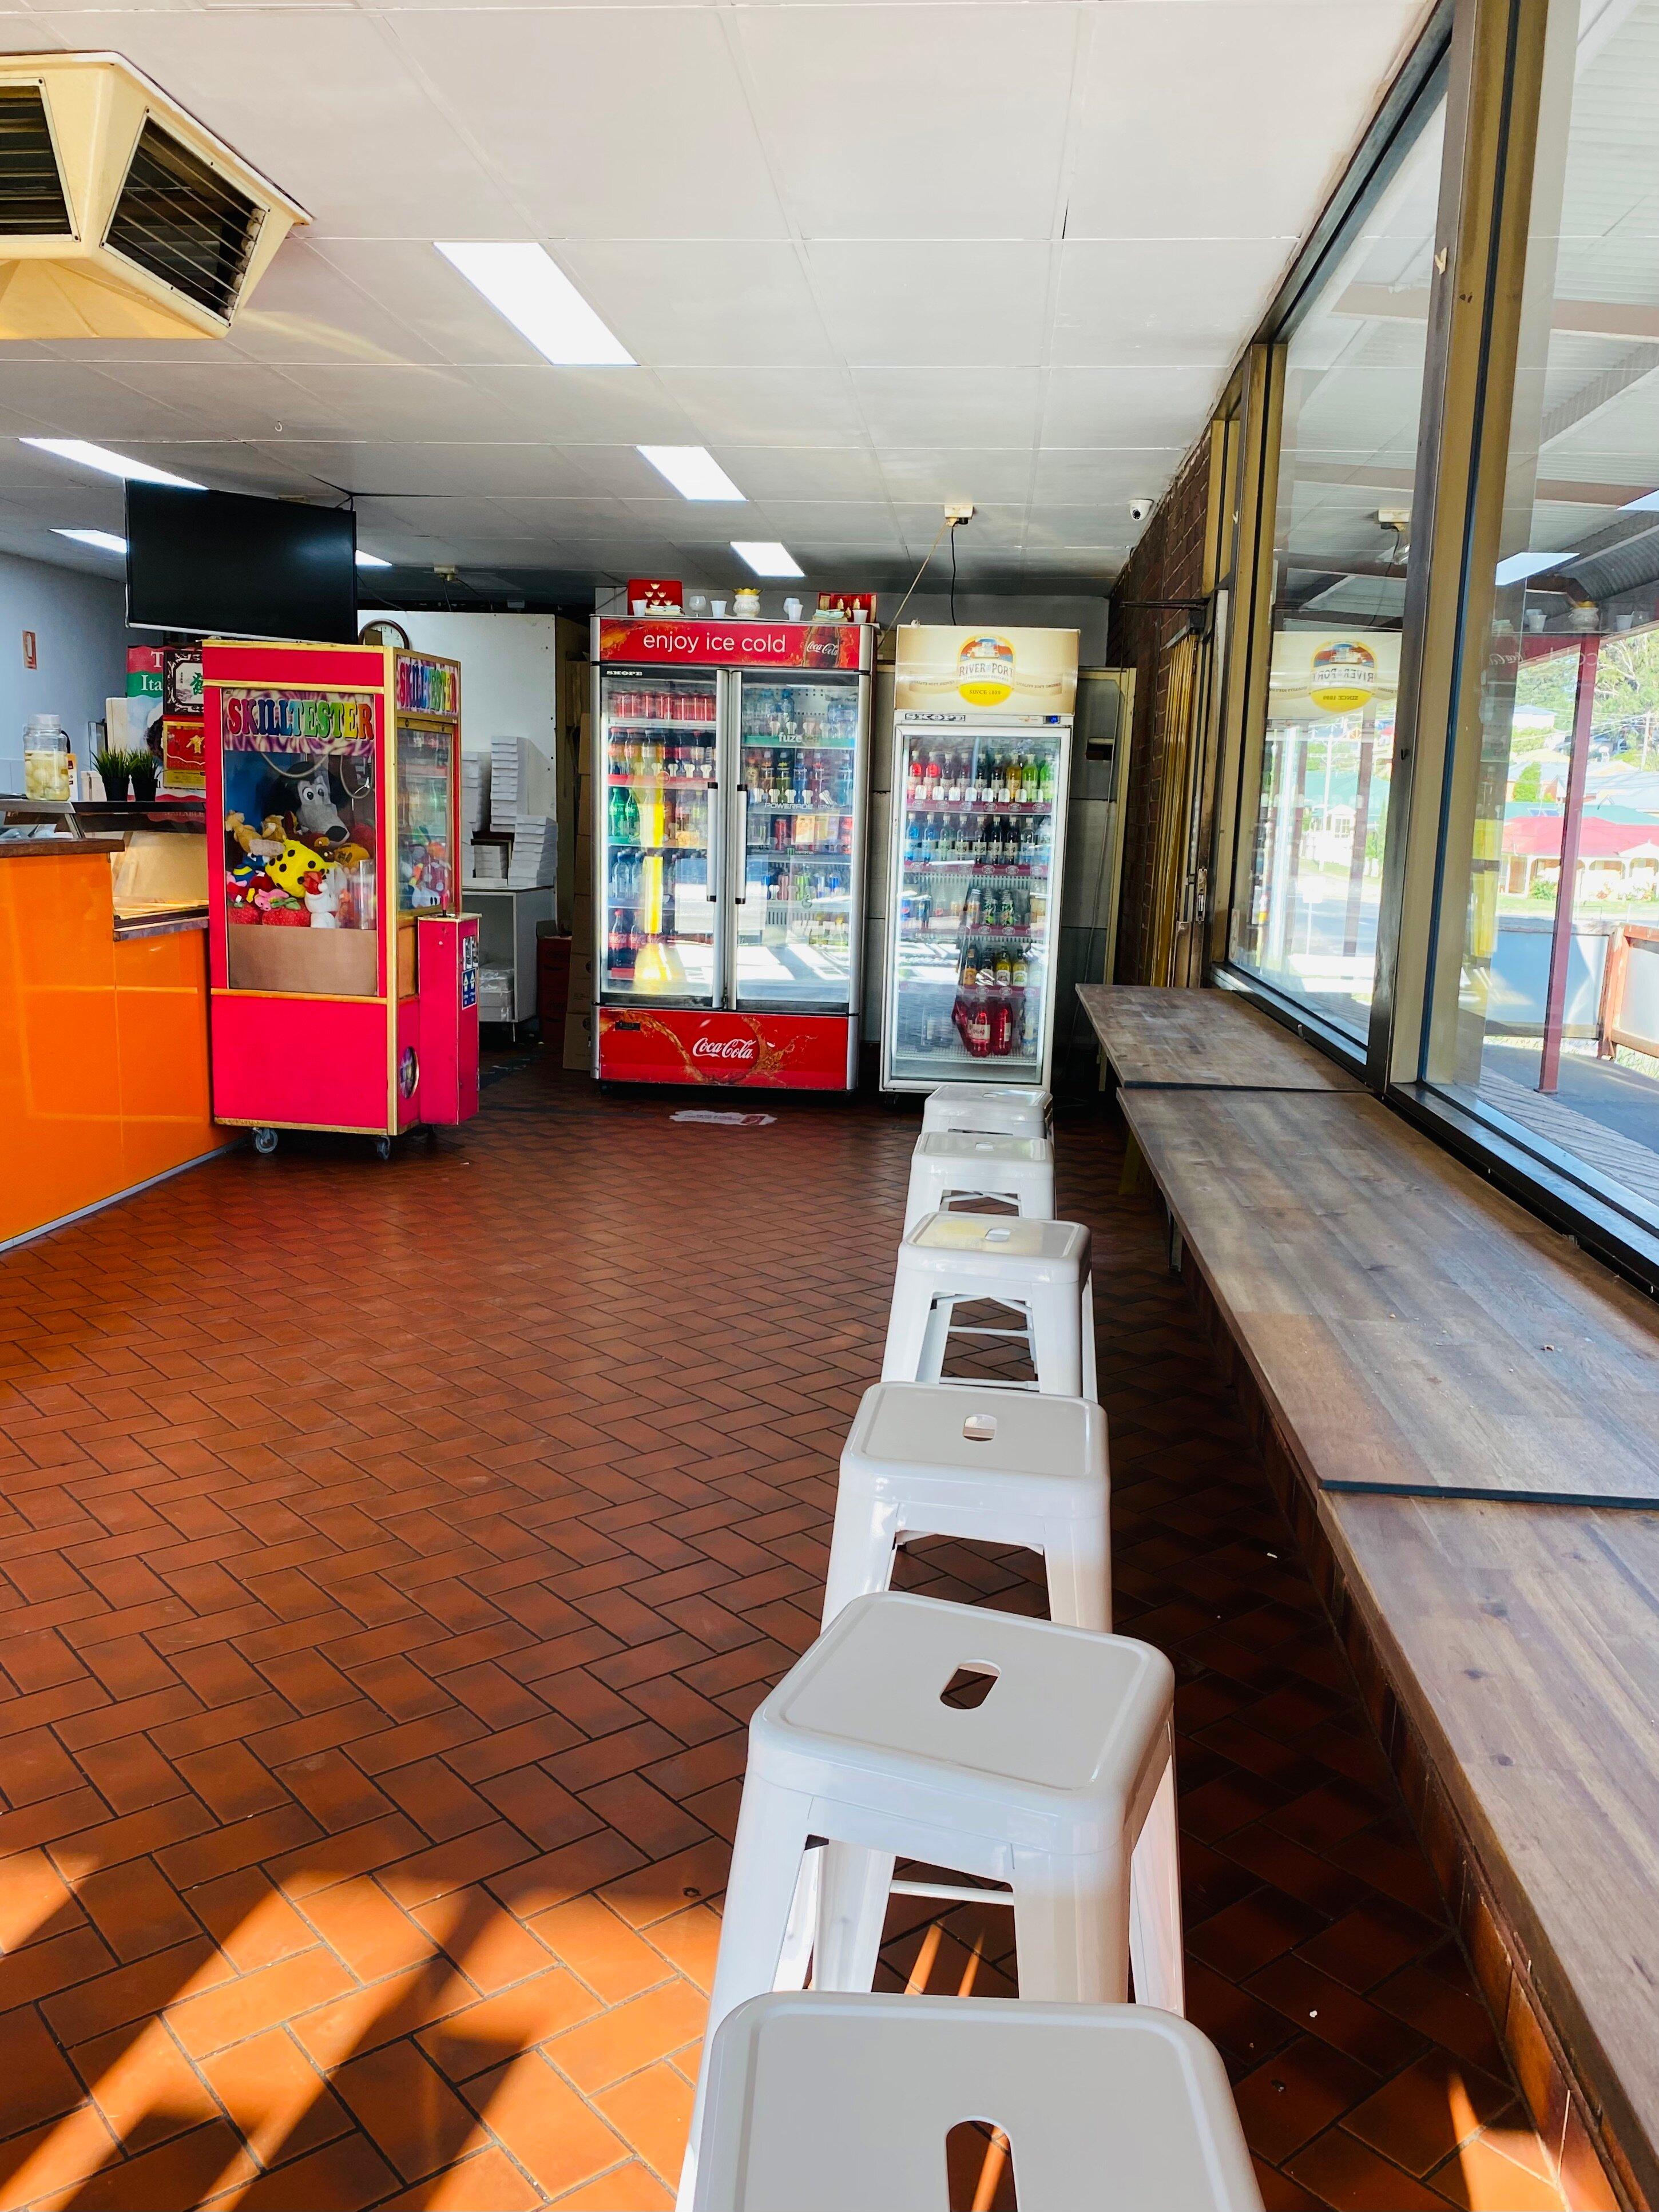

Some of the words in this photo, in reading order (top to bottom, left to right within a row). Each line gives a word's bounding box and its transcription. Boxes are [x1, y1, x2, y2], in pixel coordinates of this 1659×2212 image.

[643, 633, 700, 653] enjoy
[706, 632, 735, 651] ice
[741, 634, 786, 653] cold
[805, 640, 839, 656] Coca-Cola
[959, 663, 986, 677] RIVER
[992, 662, 1014, 677] PORT
[228, 697, 374, 740] SKILLTESTER
[905, 713, 966, 722] SKOPE
[764, 802, 813, 810] POWERADE
[692, 1037, 757, 1059] Coca-Cola
